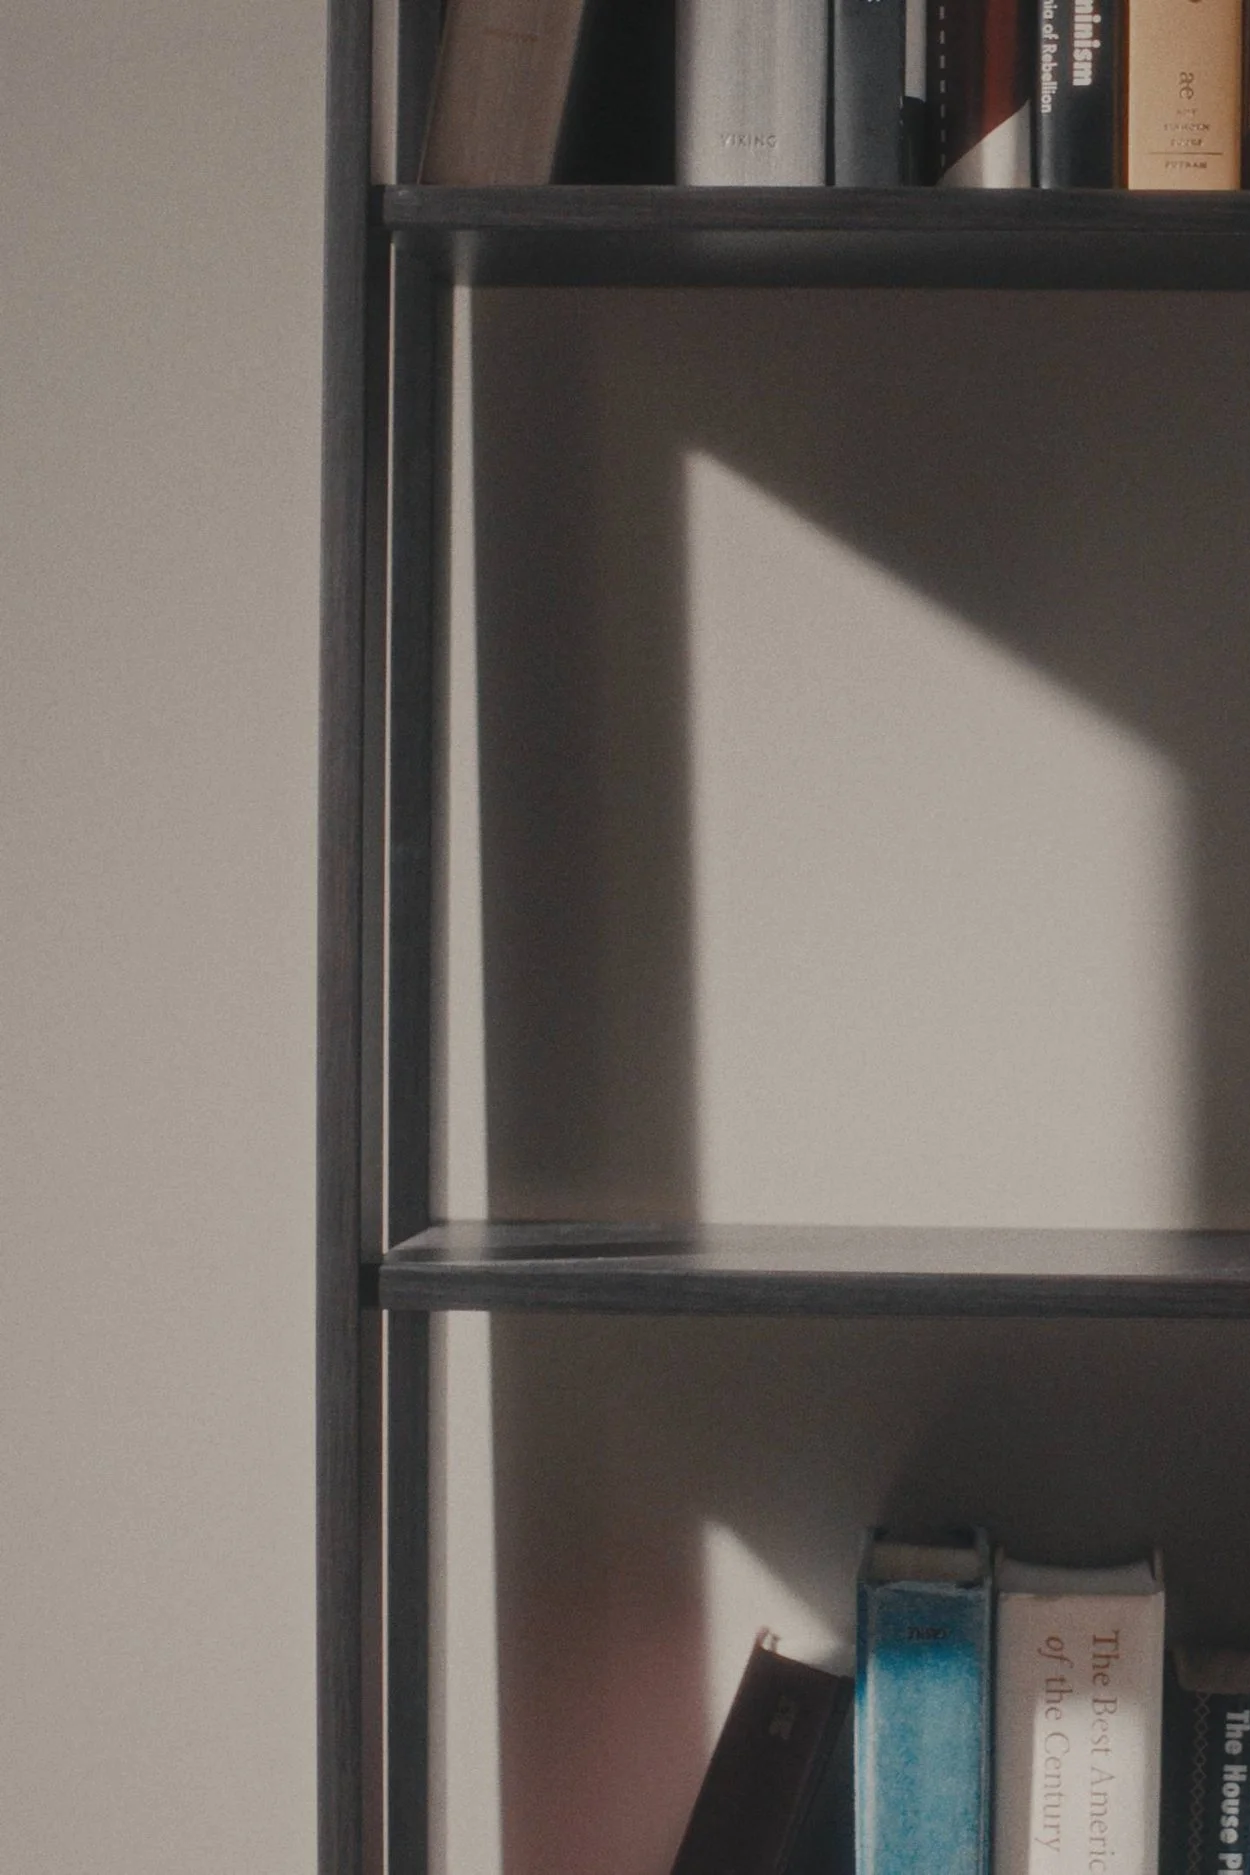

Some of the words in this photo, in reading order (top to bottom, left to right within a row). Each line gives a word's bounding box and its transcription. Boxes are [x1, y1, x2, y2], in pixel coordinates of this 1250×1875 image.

[1043, 23, 1060, 41] of
[1040, 43, 1059, 114] Rebellion
[719, 132, 777, 149] VIKING
[1037, 1635, 1074, 1669] of
[1091, 1629, 1121, 1686] The
[1043, 1676, 1074, 1722] the
[1090, 1695, 1119, 1756] Best
[1224, 1708, 1250, 1756] The
[1035, 1732, 1070, 1853] Century
[1087, 1765, 1117, 1874] Americ
[1218, 1763, 1248, 1845] House
